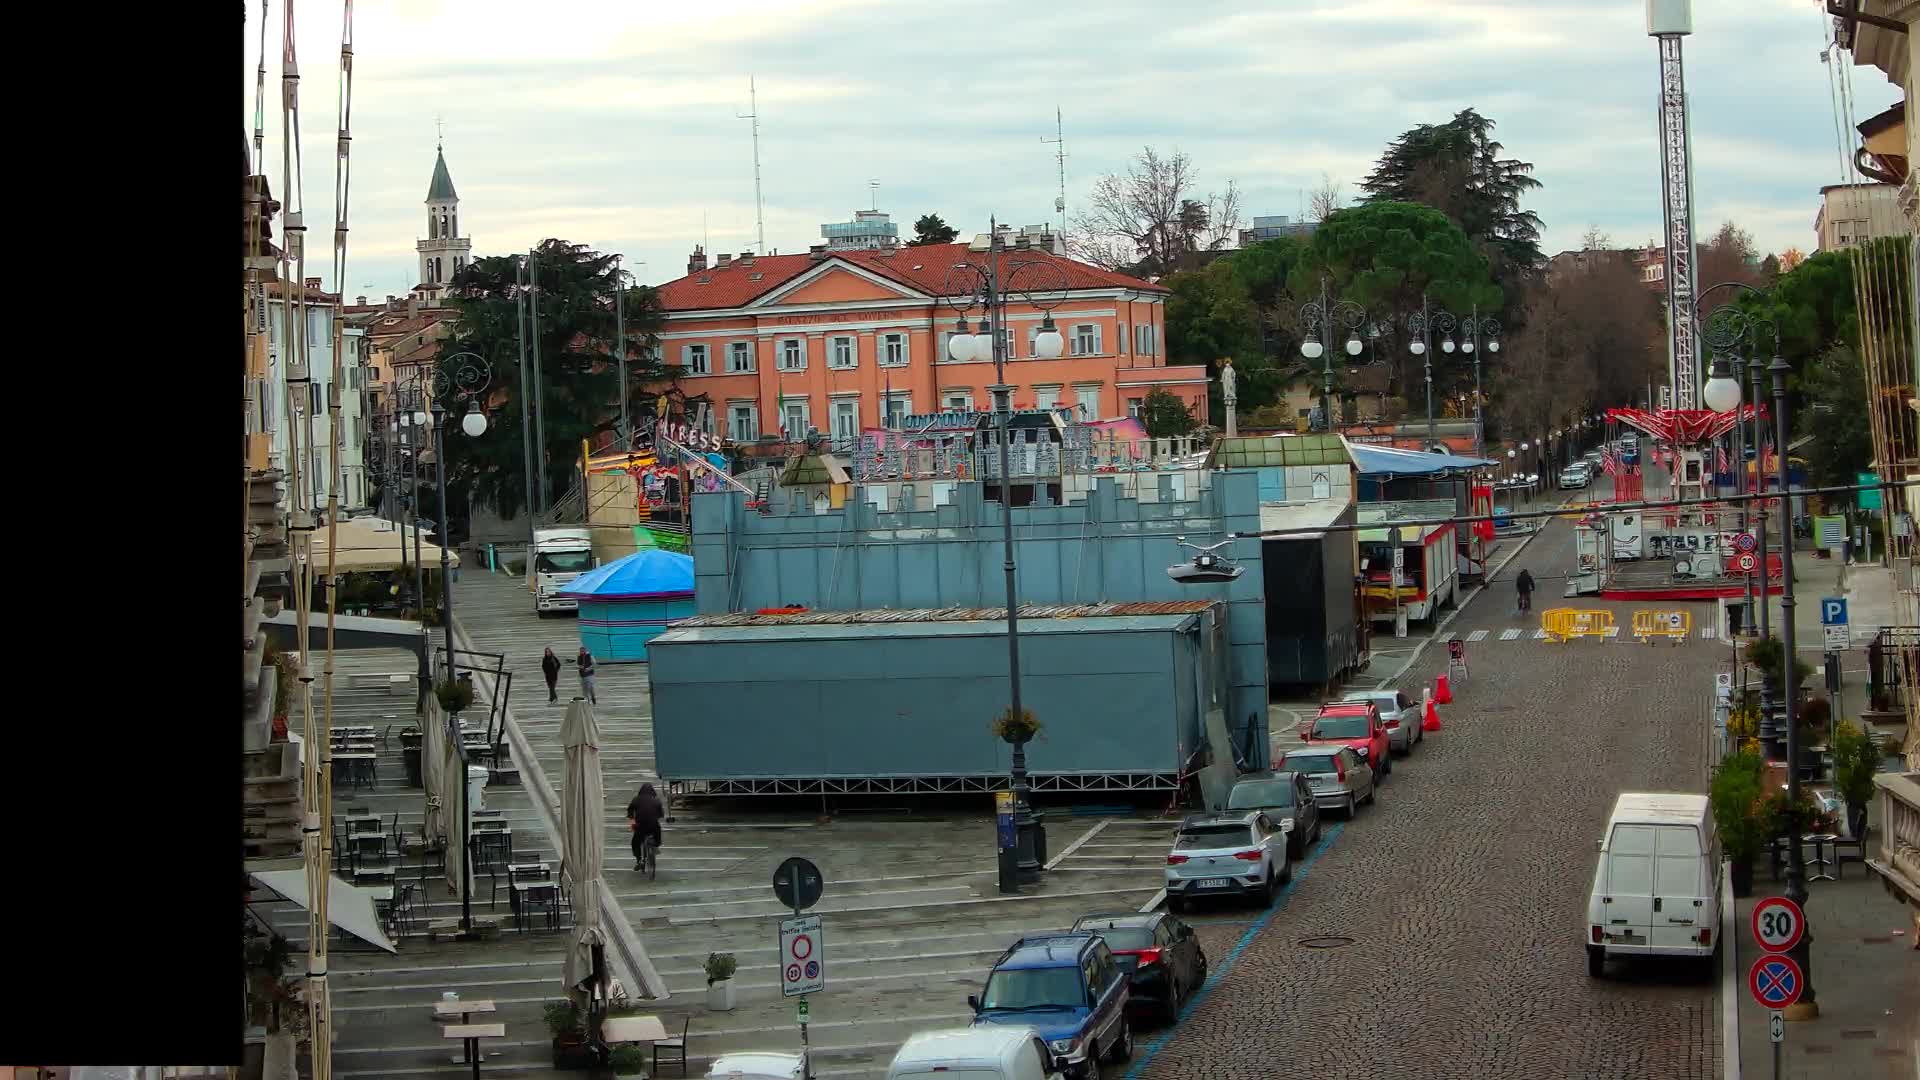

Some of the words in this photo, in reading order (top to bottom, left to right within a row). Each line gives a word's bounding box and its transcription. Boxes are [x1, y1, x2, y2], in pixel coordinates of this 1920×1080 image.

[1742, 557, 1753, 567] 20
[1826, 602, 1842, 622] P
[1762, 911, 1792, 938] 30
